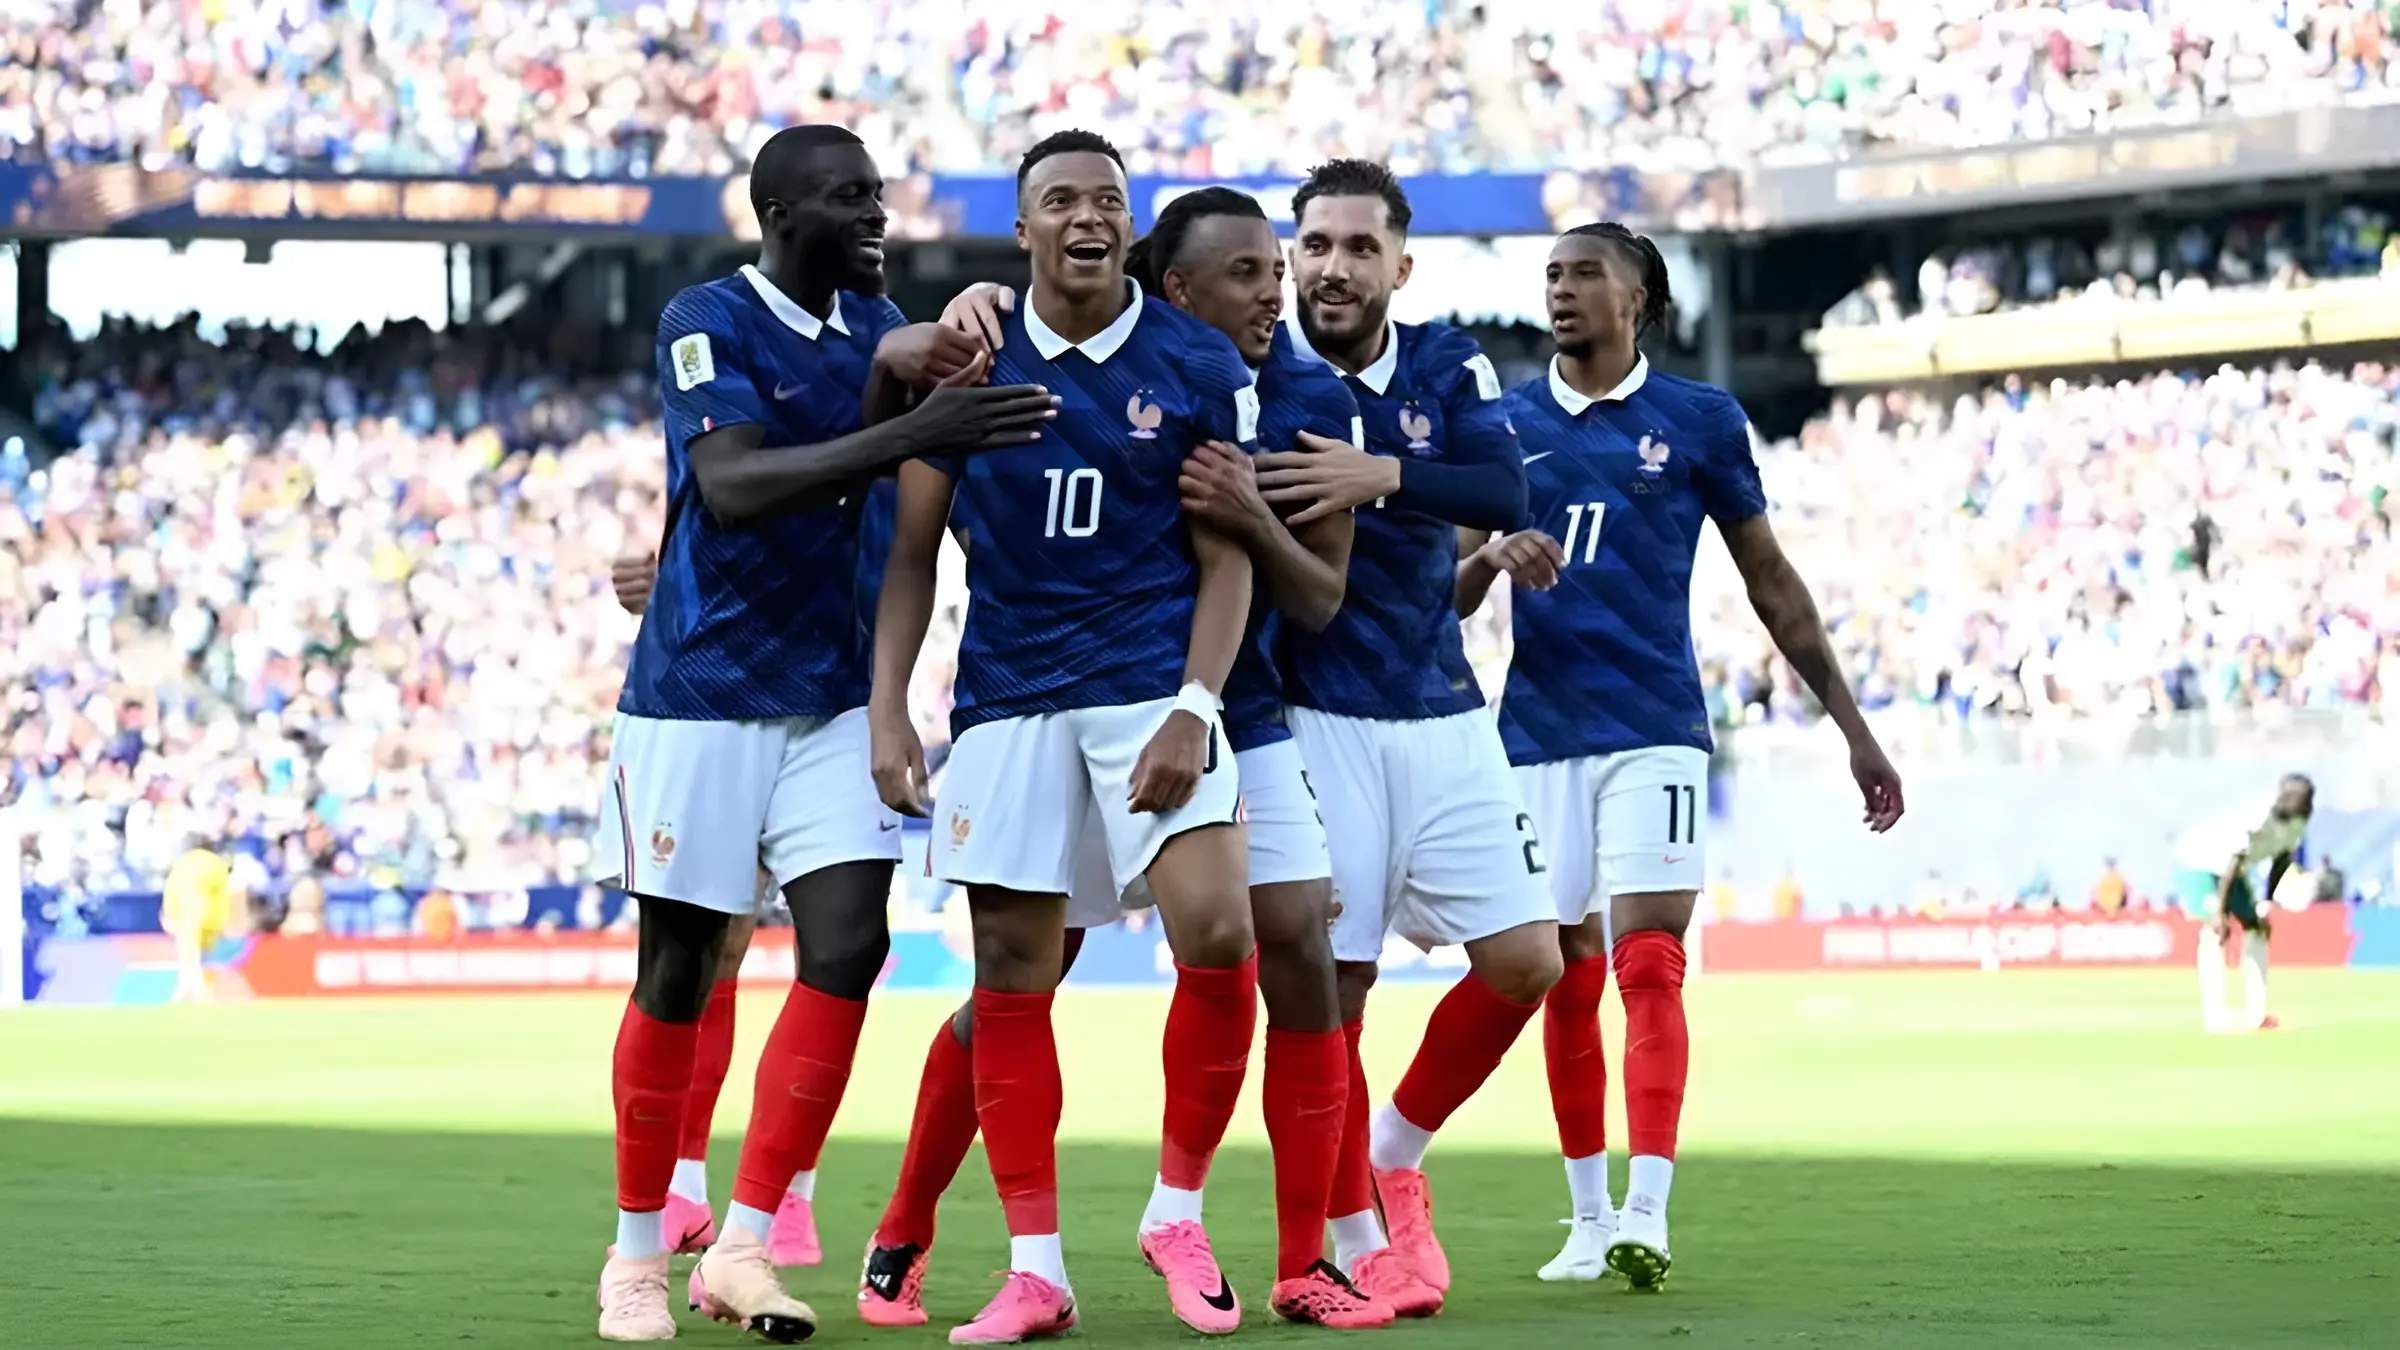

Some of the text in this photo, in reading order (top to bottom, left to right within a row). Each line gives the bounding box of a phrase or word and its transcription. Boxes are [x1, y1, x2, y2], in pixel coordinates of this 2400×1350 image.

[1044, 468, 1103, 537] 10
[1563, 502, 1606, 564] 11
[1663, 785, 1696, 843] 11
